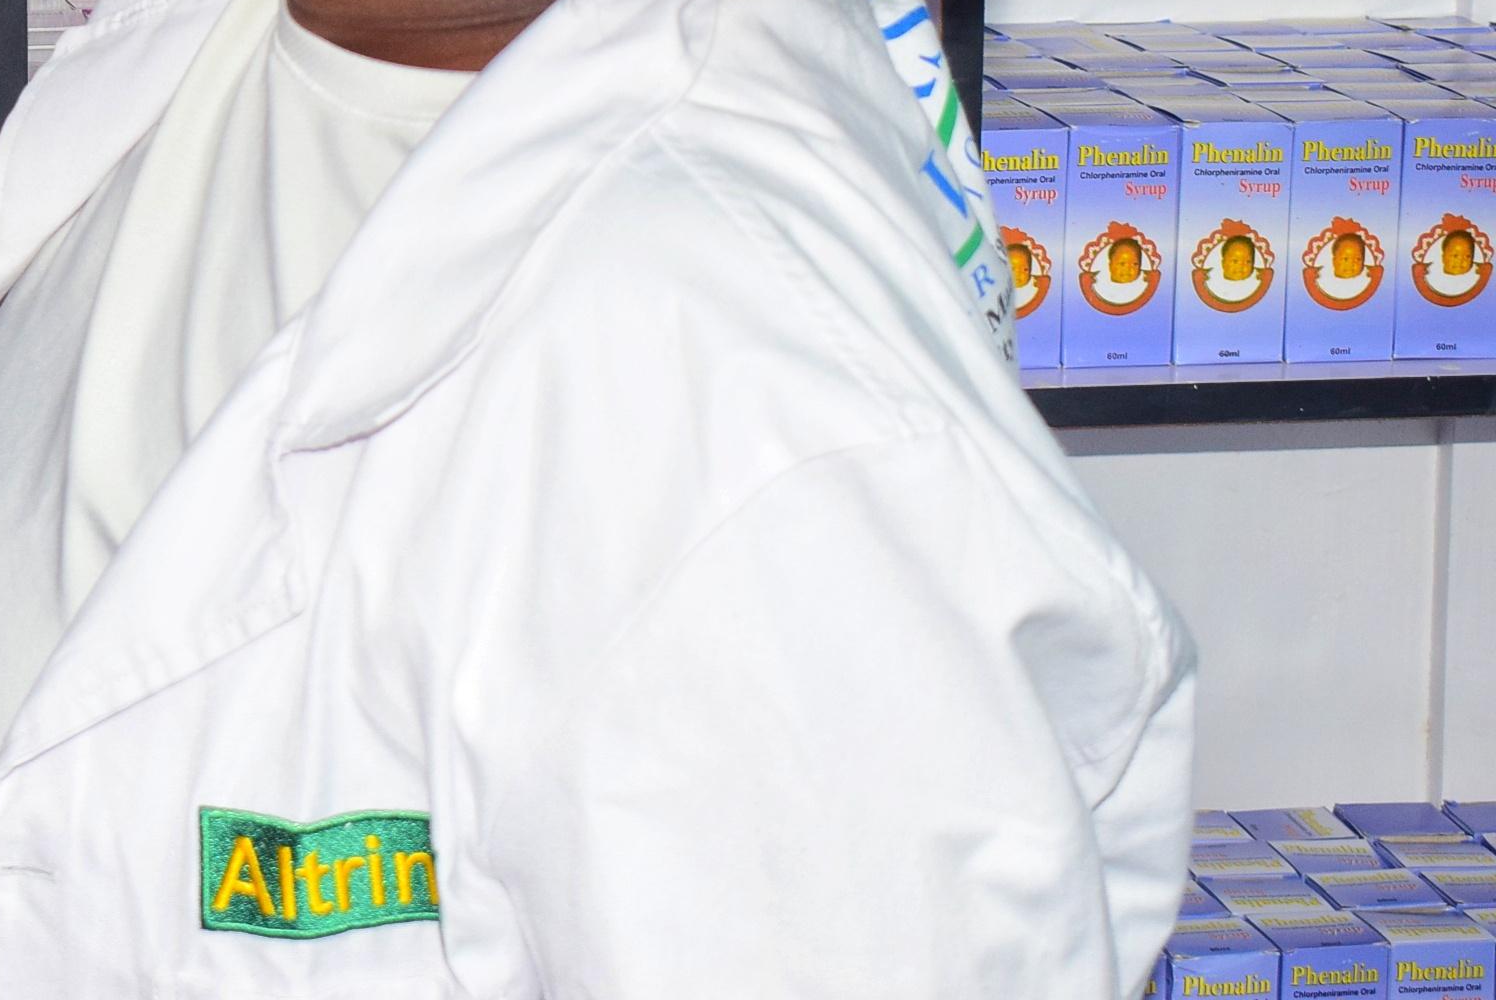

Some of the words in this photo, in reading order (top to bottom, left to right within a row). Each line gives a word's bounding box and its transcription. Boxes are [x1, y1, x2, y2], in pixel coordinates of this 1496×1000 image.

[983, 149, 1059, 171] henalin
[1077, 144, 1169, 167] Phenalin
[1192, 142, 1284, 163] Phenalin
[1302, 140, 1392, 162] Phenalin
[1304, 166, 1371, 175] Chlorpheniramine
[1015, 186, 1057, 204] Syrup
[1125, 181, 1168, 200] Syrup
[1239, 179, 1281, 198] Syrup
[1349, 177, 1390, 195] Syrup
[213, 835, 439, 921] Altrin
[1291, 963, 1378, 986] Phenalin
[1396, 960, 1485, 982] Phenalin
[1183, 975, 1271, 996] Phenalin
